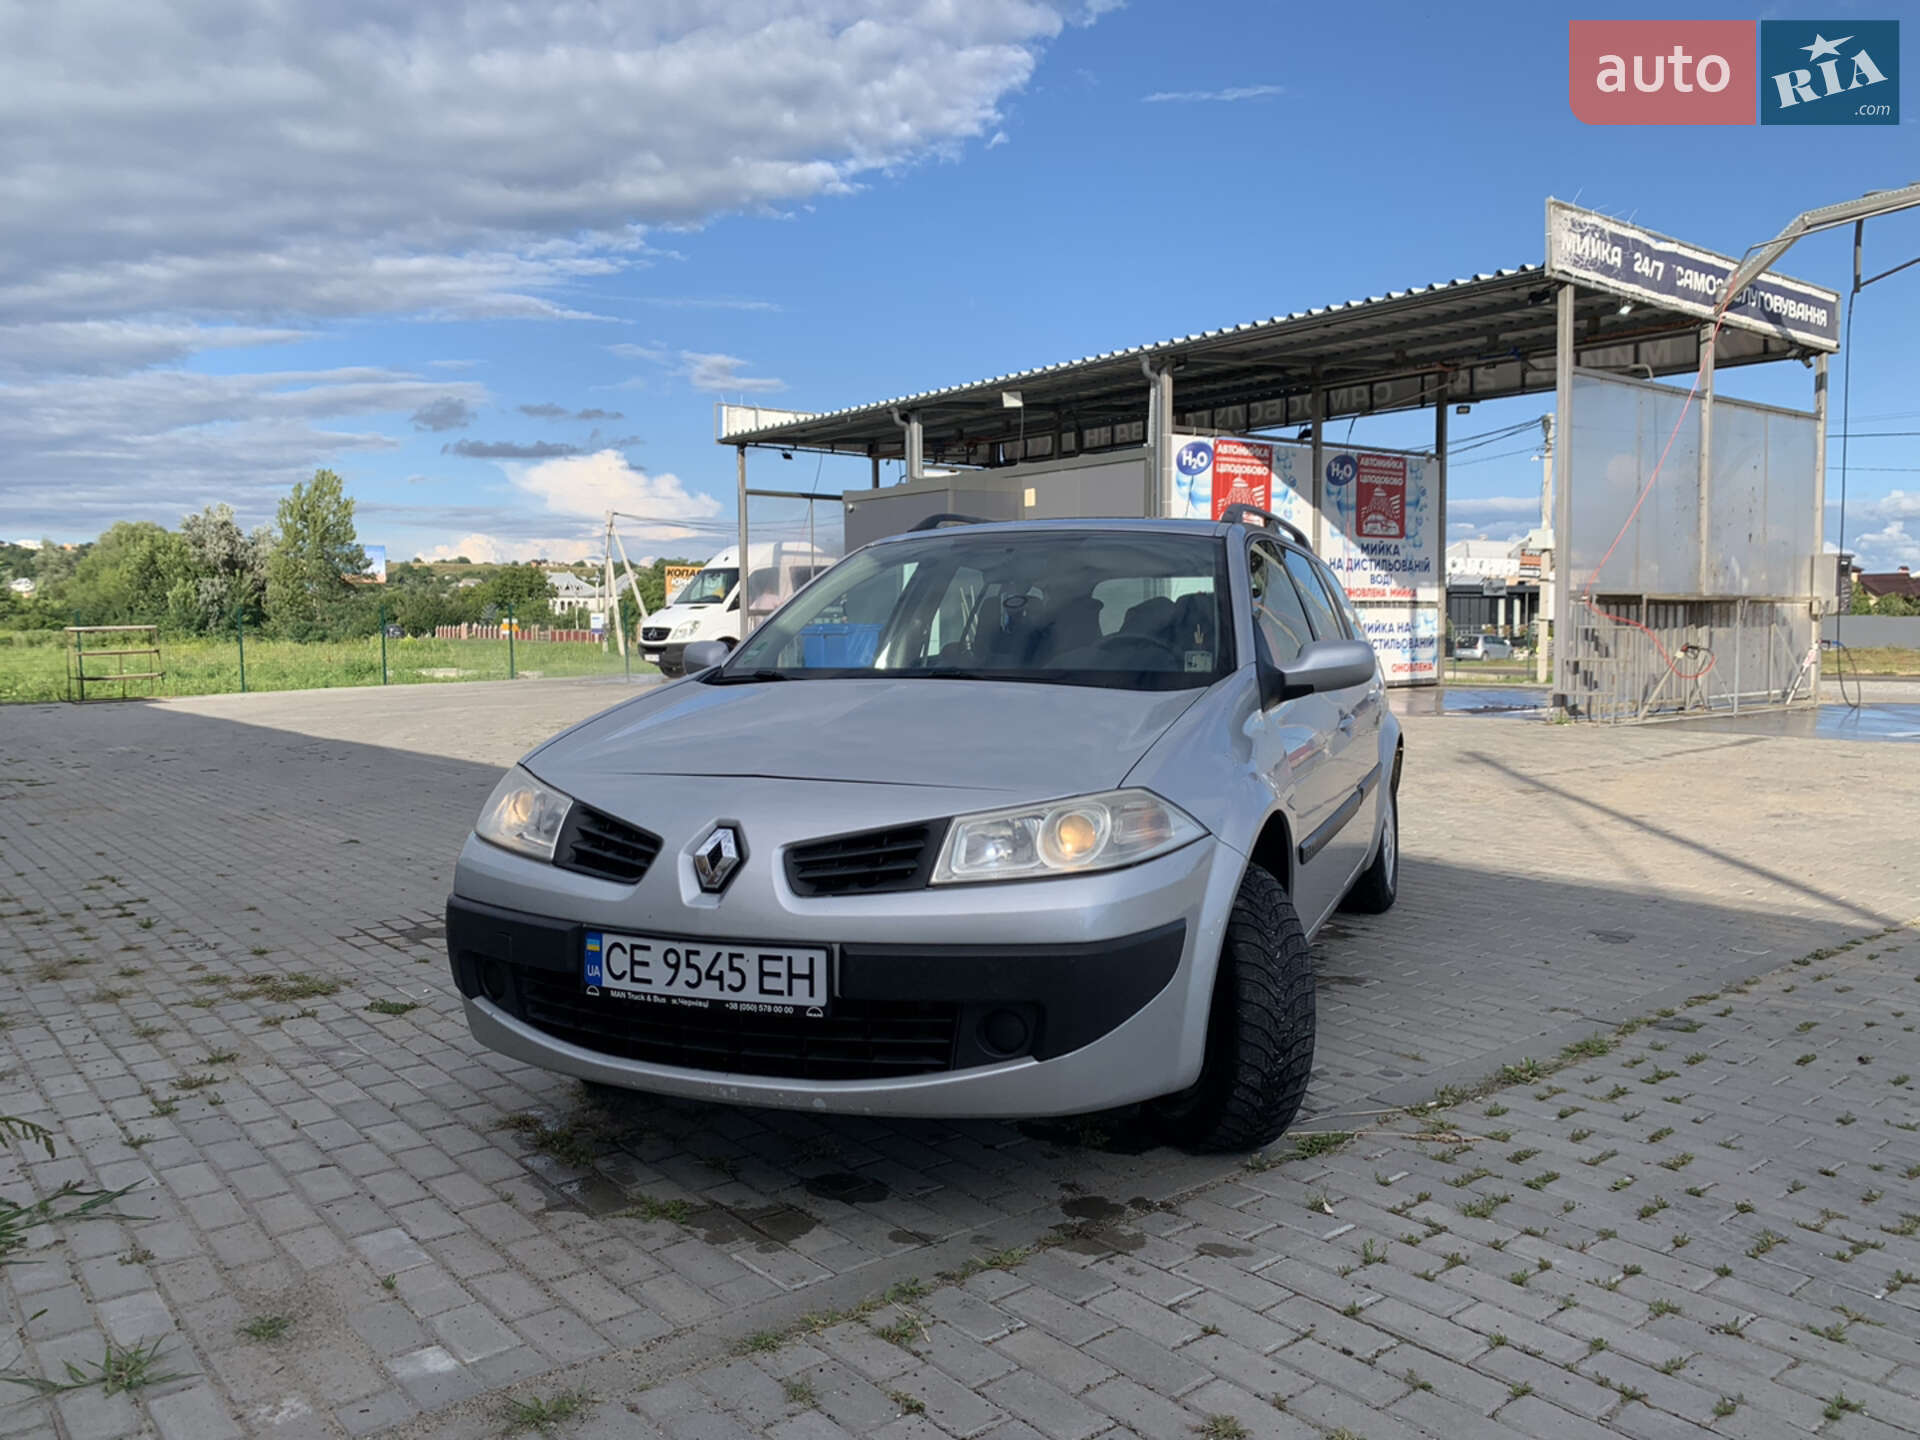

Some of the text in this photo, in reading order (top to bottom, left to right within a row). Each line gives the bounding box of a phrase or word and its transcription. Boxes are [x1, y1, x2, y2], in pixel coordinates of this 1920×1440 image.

[1561, 233, 1828, 327] МИЙКА 24/7 САМОЛУГОВУВАННЯ
[1361, 540, 1400, 556] МИЙКА
[1329, 557, 1430, 572] НА ДИСТИЛЬОВАНІЙ
[1370, 635, 1434, 650] СТИЛЬОВАНІЙ
[587, 964, 601, 977] UA
[606, 942, 815, 997] CE 9545 EH
[610, 990, 626, 999] MAN
[773, 1006, 783, 1014] 00
